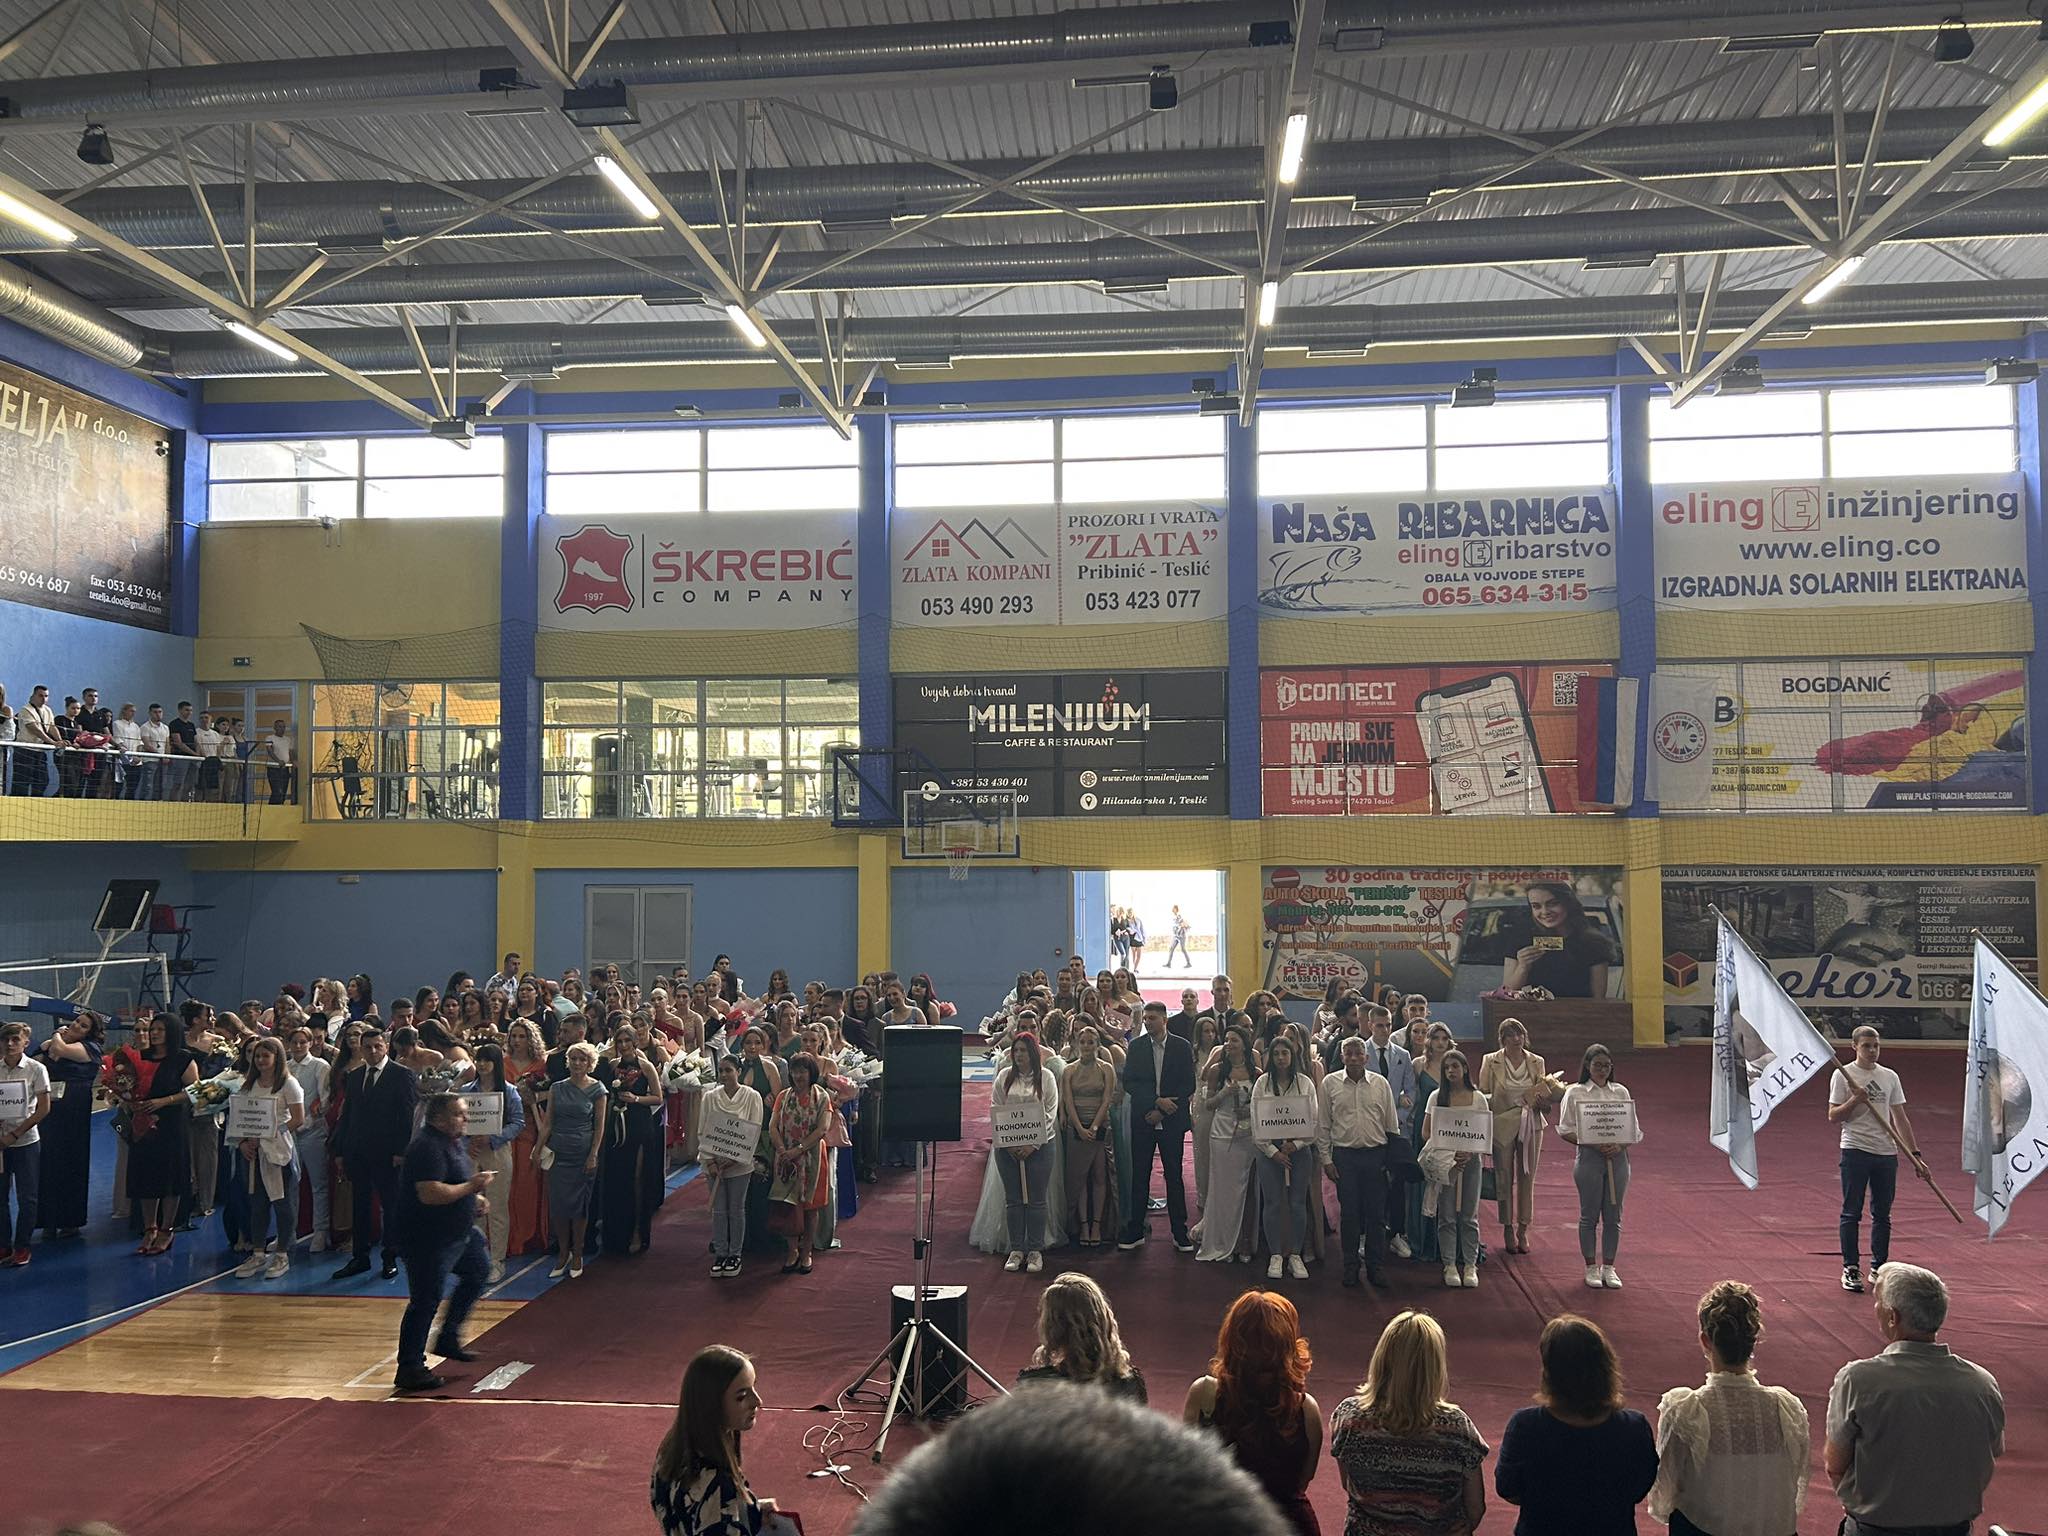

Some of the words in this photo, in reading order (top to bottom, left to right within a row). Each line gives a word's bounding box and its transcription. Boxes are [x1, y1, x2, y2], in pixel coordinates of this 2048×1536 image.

[0, 380, 88, 456] ELJA"
[93, 417, 131, 446] d.o.o.
[1398, 496, 1610, 540] RIBARNICA
[1662, 492, 1764, 531] eling
[1827, 487, 2019, 522] inžinjering
[1068, 513, 1145, 528] PROZORI
[1150, 512, 1156, 526] I
[1160, 510, 1219, 525] VRATA
[1398, 543, 1460, 567] eling
[1496, 538, 1612, 560] ribarstvo
[1739, 535, 1941, 563] www.eling.co
[652, 540, 853, 583] ŠKREBIĆ
[1078, 562, 1145, 580] Pribinić
[1162, 560, 1210, 577] Teslić
[20, 570, 44, 589] 964
[47, 576, 71, 594] 687
[902, 566, 958, 583] ZLATA
[966, 563, 1051, 583] KOMPANI
[1424, 573, 1470, 583] OBALA
[1473, 571, 1537, 582] VOJVODE
[1542, 569, 1585, 580] STEPE
[90, 574, 106, 588] fax:
[107, 578, 125, 592] 053
[126, 583, 143, 597] 432
[145, 587, 162, 601] 964
[1662, 575, 1783, 599] IZGRADNJA
[1789, 571, 1898, 595] SOLARNIH
[1905, 567, 2027, 593] ELEKTRANA
[583, 592, 604, 602] 1997
[653, 588, 853, 603] COMPANY
[1086, 592, 1120, 611] 053
[1126, 591, 1160, 609] 423
[1167, 589, 1201, 608] 077
[1422, 586, 1471, 606] 065
[1480, 585, 1529, 604] 634
[1538, 583, 1589, 603] 315
[921, 598, 954, 616] 053
[960, 596, 993, 615] 490
[1000, 595, 1034, 614] 293
[1782, 671, 1891, 693] BOGDANIĆ
[969, 703, 1150, 732] MILENIJUM
[1365, 721, 1395, 741] SVE
[1004, 738, 1037, 748] CAFFE
[1038, 738, 1046, 747] &
[1048, 737, 1114, 747] RESTAURANT
[1291, 743, 1316, 764] NA
[976, 778, 989, 787] 53
[991, 778, 1009, 787] 430
[1011, 778, 1028, 787] 401
[1291, 765, 1395, 797] MJESTU
[1011, 795, 1029, 804] 00
[1454, 791, 1477, 801] SERVIS
[1325, 868, 1350, 884] 30
[1353, 869, 1404, 884] godina
[1409, 869, 1473, 884] tradicije
[1477, 869, 1483, 881] i
[1696, 869, 1737, 877] UGRADNJA
[1739, 869, 1780, 877] BETONSKE
[1781, 869, 1834, 877] GALANTERIJE
[1887, 869, 1936, 877] KOMPLETNO
[1981, 869, 2035, 877] EKSTERIJERA
[1264, 887, 1299, 900] AUTO
[1969, 896, 2030, 905] GALANTERIJA
[1920, 925, 1980, 934] DEKORATIV
[1982, 926, 2015, 934] KAMEN
[1283, 963, 1360, 976] PERIŠIĆ
[1764, 953, 1912, 999] ekor
[1922, 983, 1958, 999] 066
[1011, 1111, 1018, 1119] IV
[1261, 1118, 1306, 1126] ГИМНАЗИЈА
[1454, 1119, 1462, 1127] IV
[995, 1121, 1041, 1131] ЕКОНОМСКИ
[1438, 1130, 1485, 1140] ГИМНАЗИЈА
[1000, 1133, 1038, 1143] ТЕХНИЧАР
